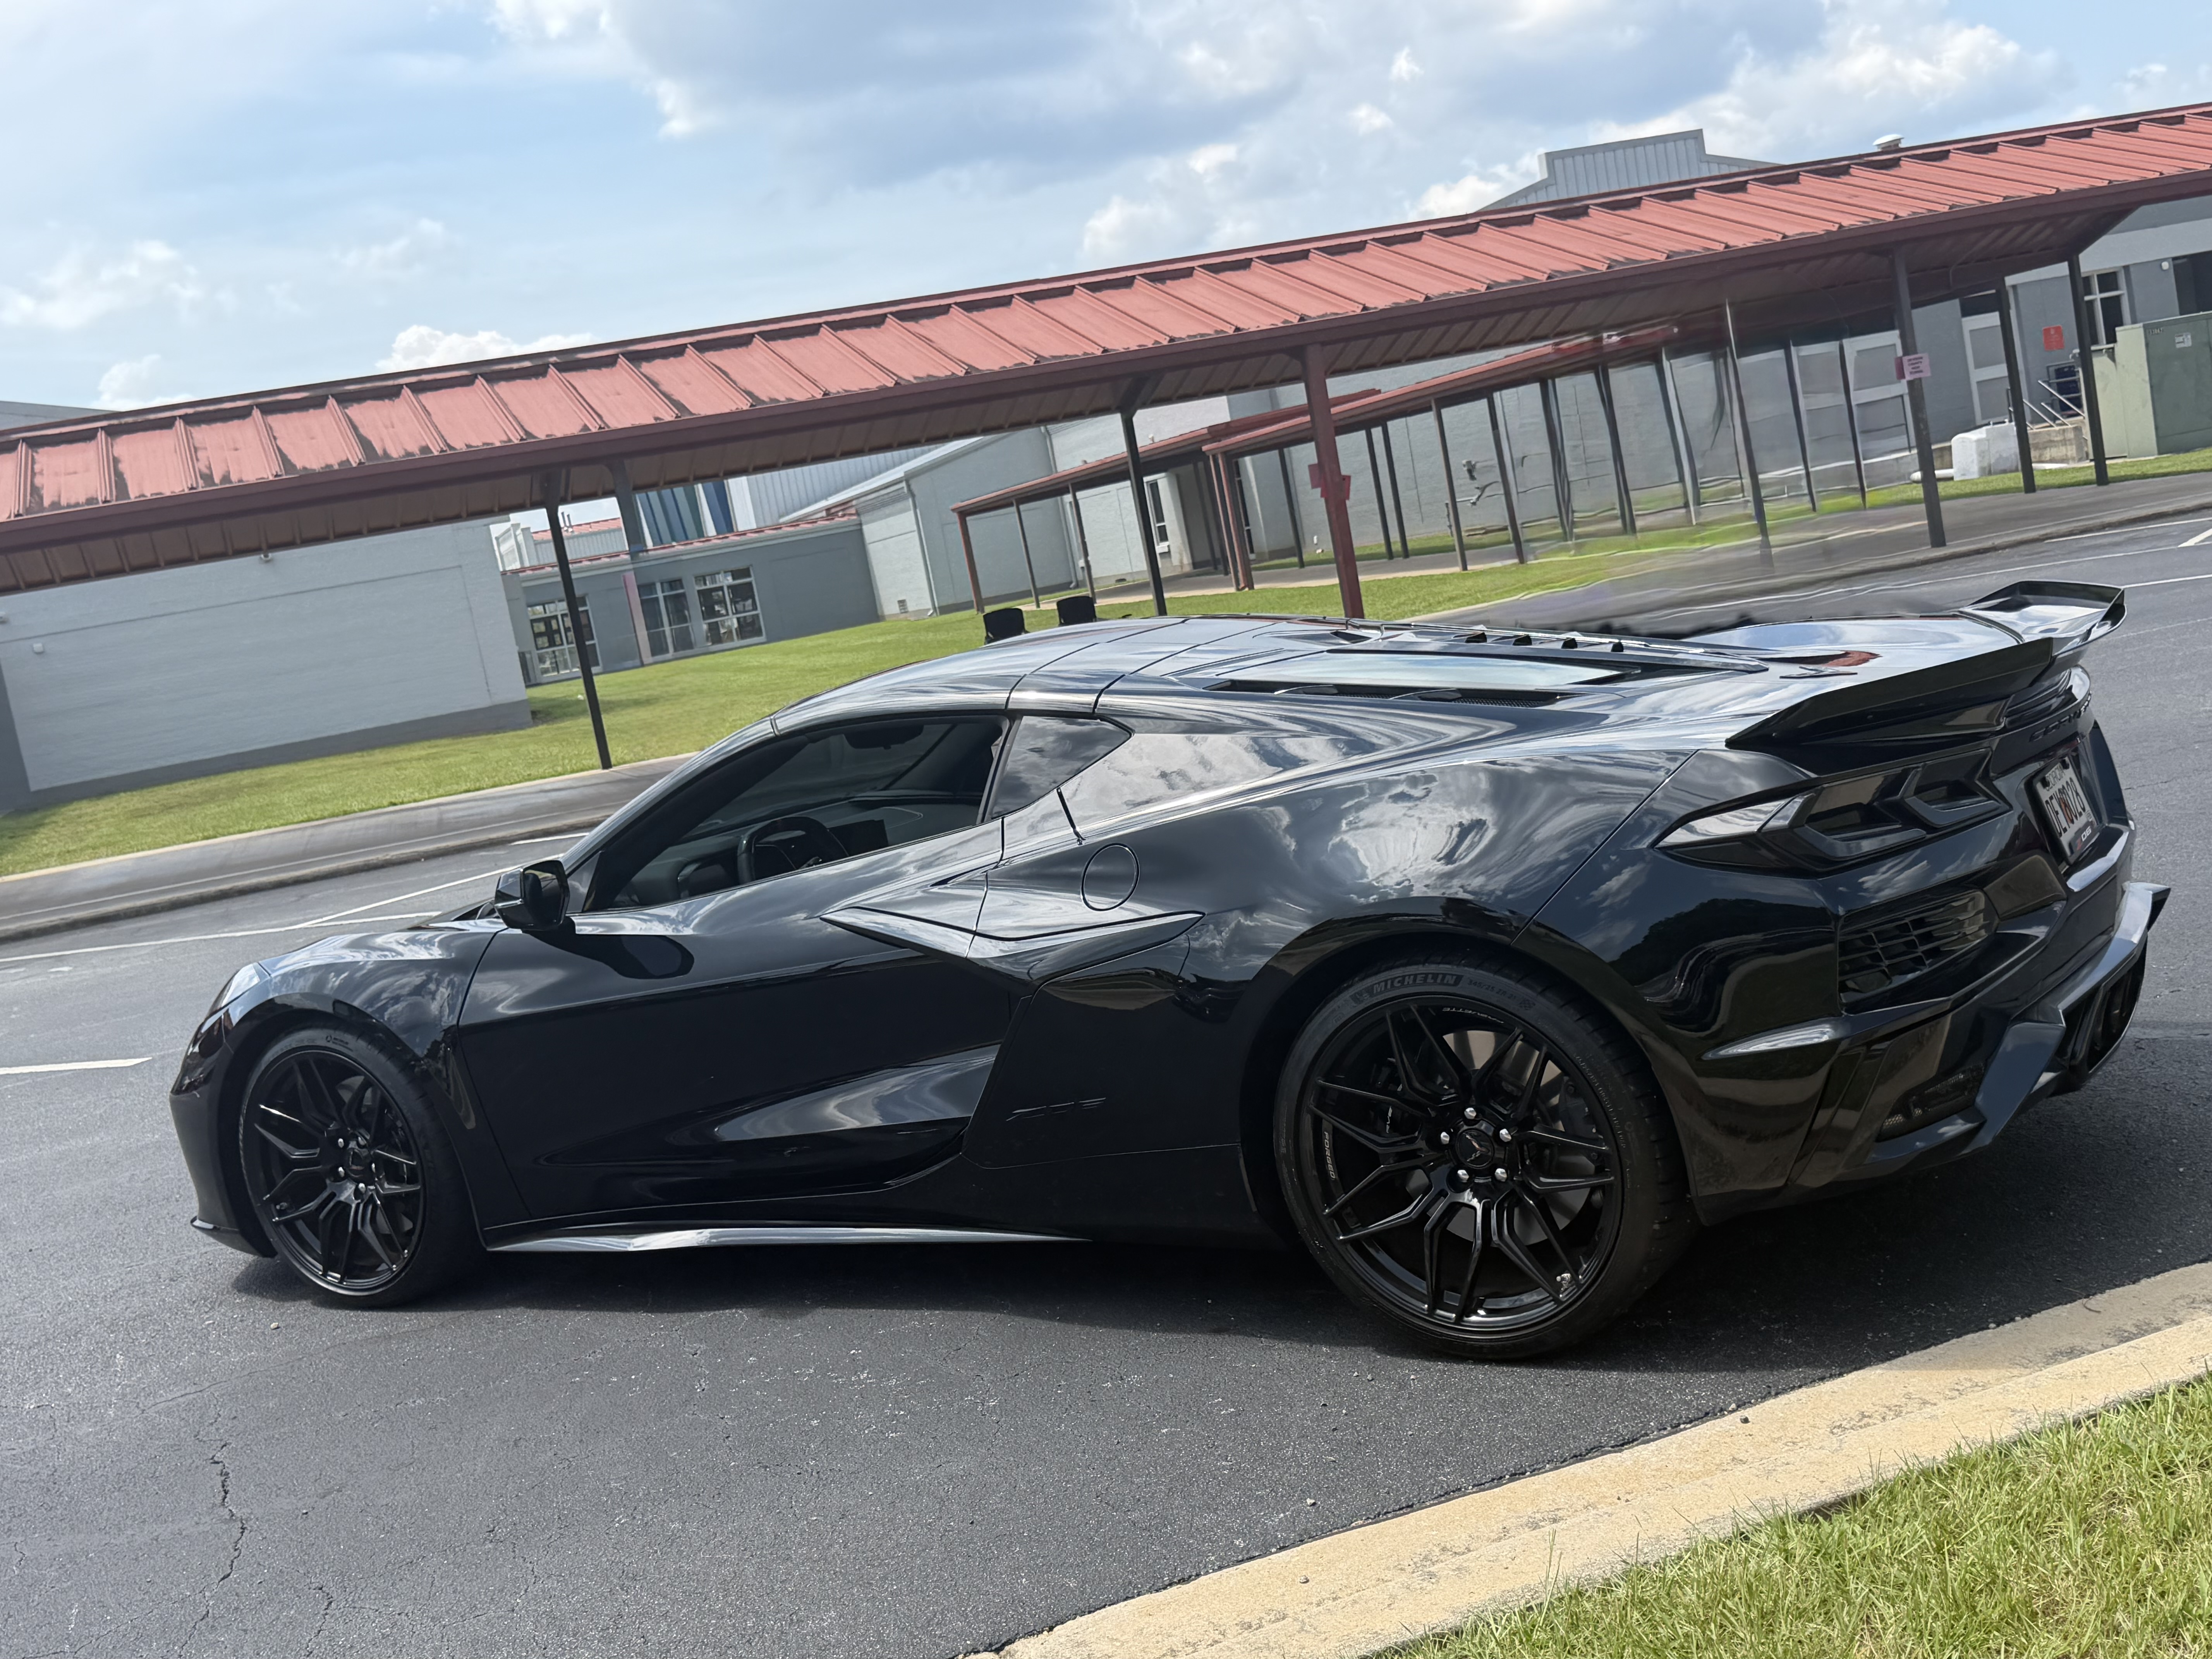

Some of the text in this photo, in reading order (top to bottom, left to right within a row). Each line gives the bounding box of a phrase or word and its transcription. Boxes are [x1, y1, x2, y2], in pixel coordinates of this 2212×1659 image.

[2045, 777, 2086, 838] DEY8028
[1373, 974, 1457, 994] MICHELIN
[1324, 1131, 1336, 1180] FORGED
